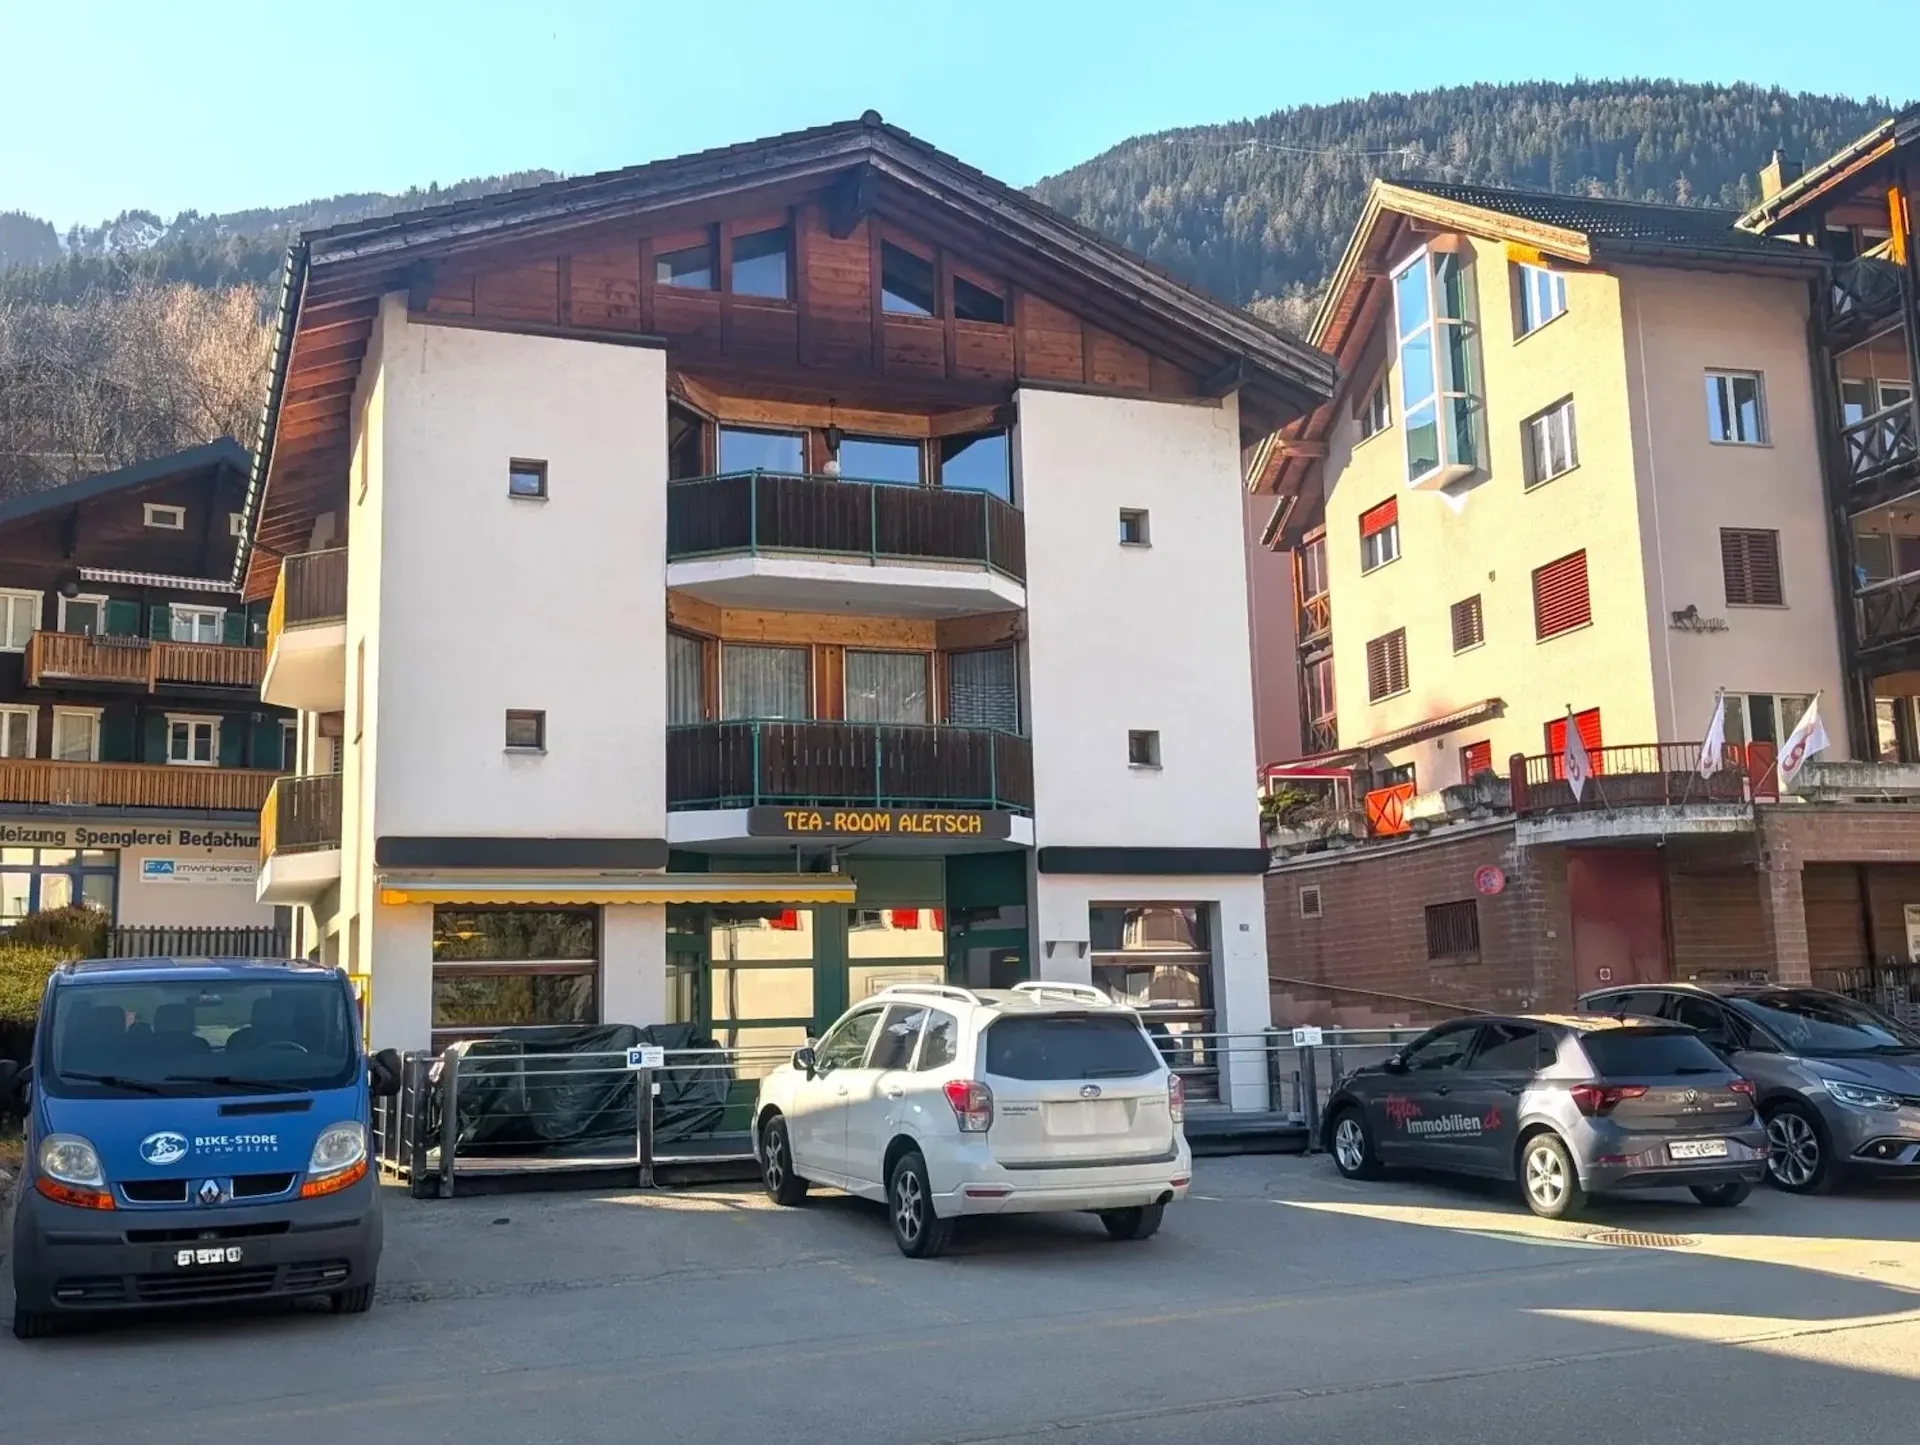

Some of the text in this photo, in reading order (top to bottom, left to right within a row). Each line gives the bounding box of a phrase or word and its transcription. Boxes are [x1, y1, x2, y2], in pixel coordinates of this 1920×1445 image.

[898, 813, 982, 834] ALETSCH
[75, 827, 172, 848] Spenglerei
[1406, 1114, 1481, 1133] Immobilien
[195, 1135, 278, 1146] BIKE-STORE
[195, 1145, 279, 1154] SCHWEIZER
